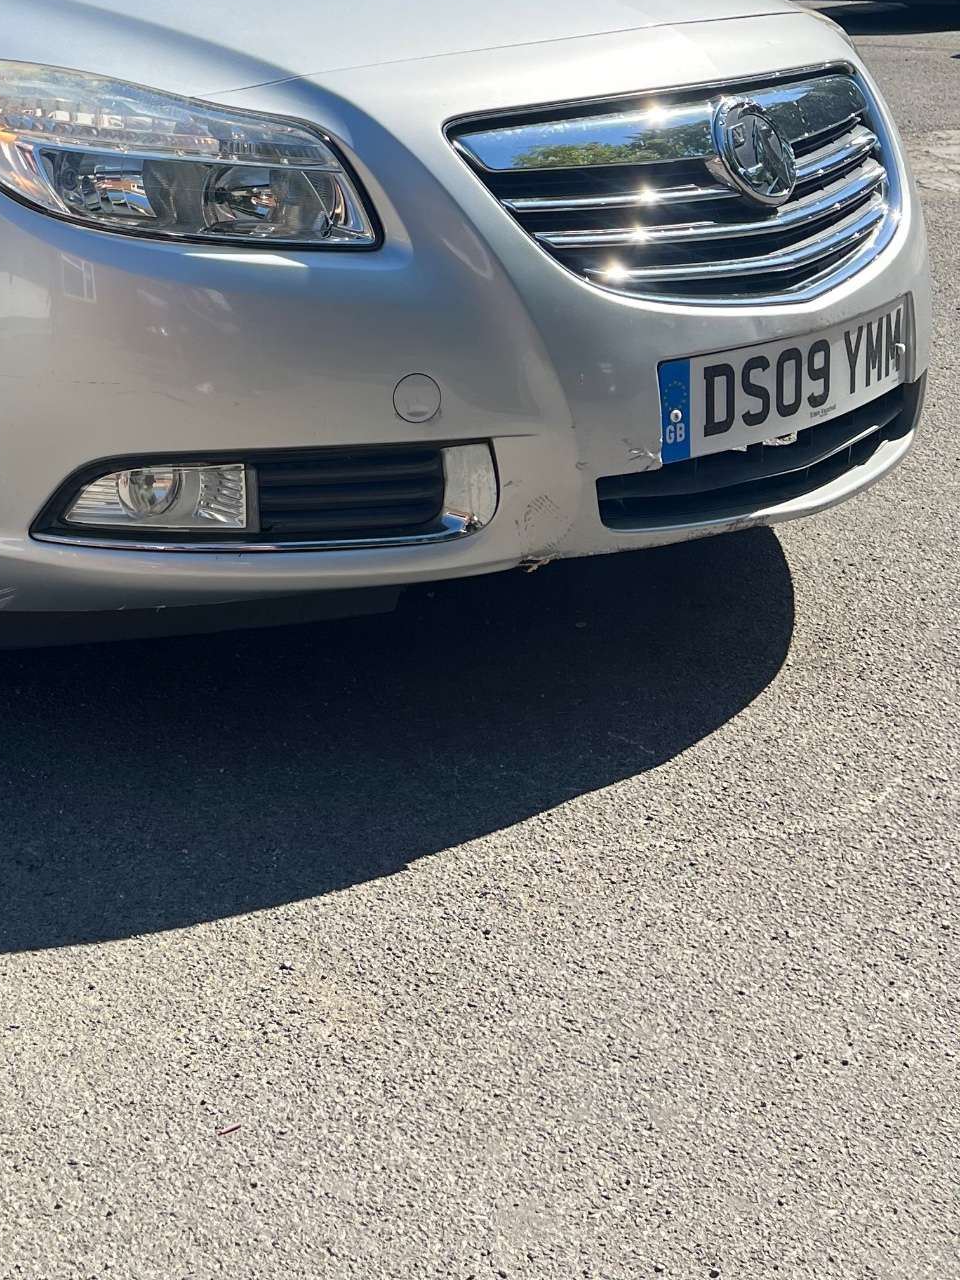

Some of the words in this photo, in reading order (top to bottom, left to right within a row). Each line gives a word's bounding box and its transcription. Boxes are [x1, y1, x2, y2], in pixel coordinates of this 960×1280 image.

[703, 338, 831, 438] DS09
[844, 308, 901, 394] YMM
[665, 423, 686, 444] GB
